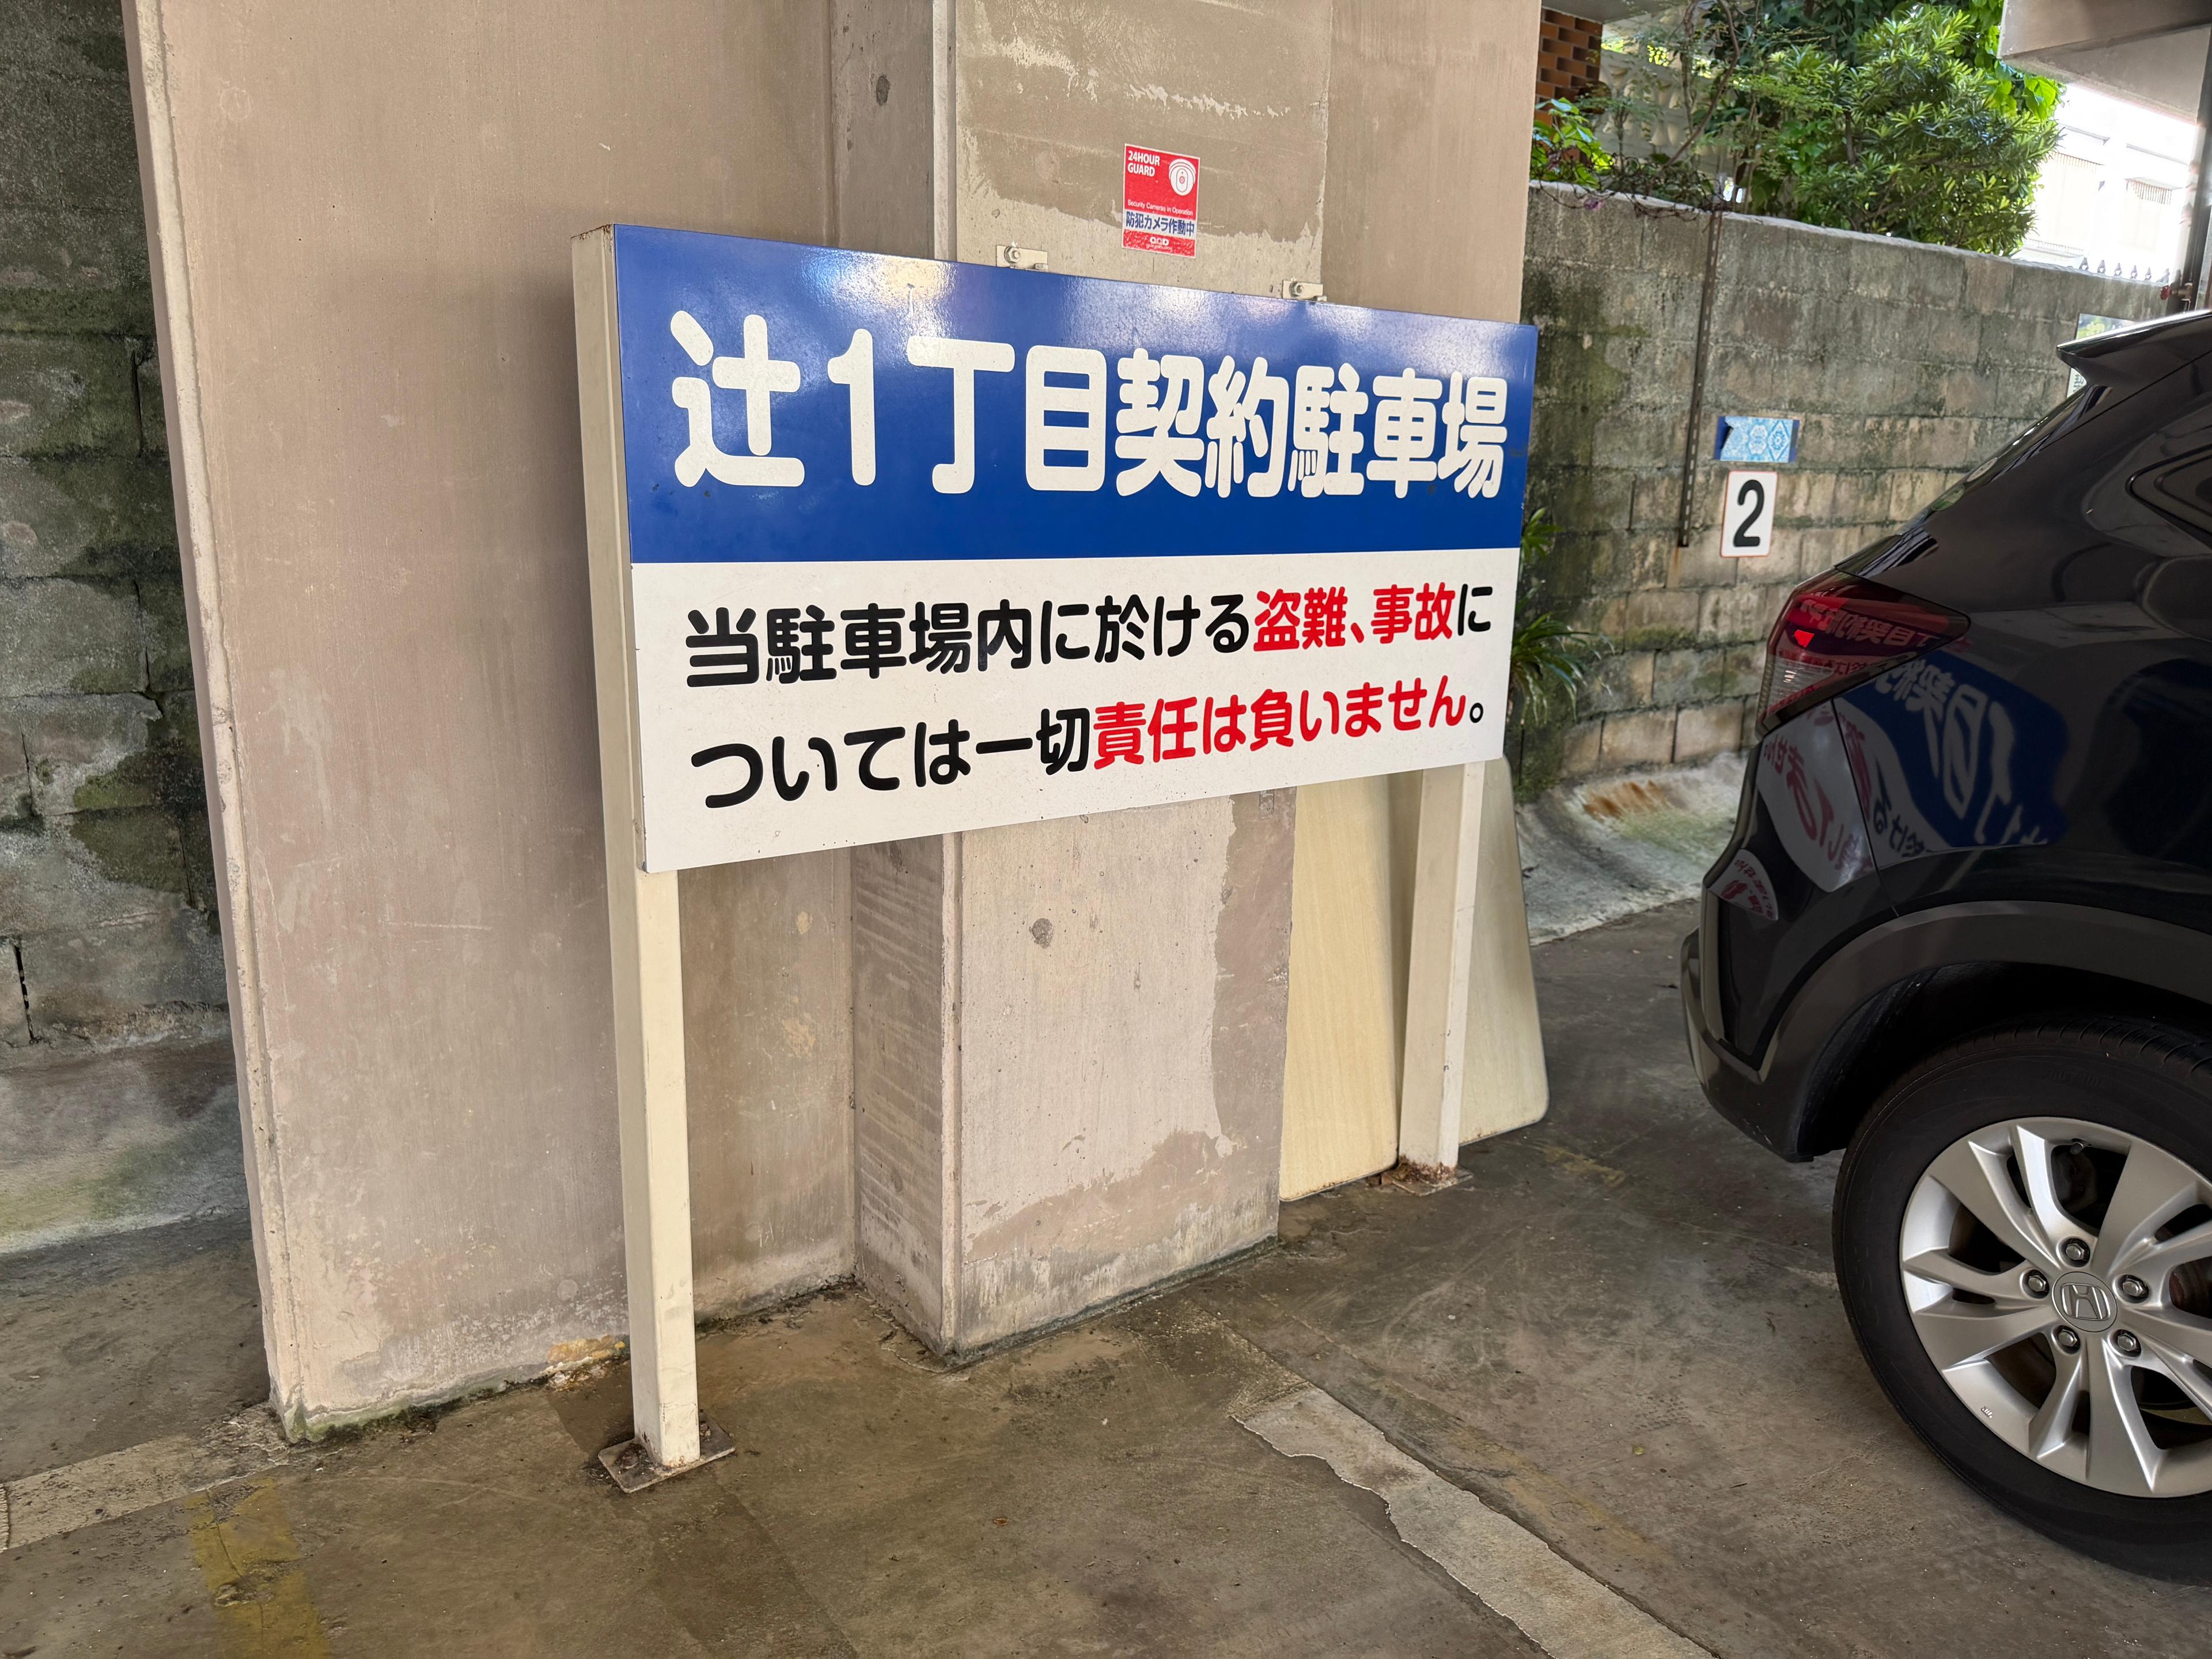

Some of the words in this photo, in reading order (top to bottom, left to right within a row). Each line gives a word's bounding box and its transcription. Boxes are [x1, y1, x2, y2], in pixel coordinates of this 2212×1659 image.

[1127, 162, 1156, 176] GUARD
[1128, 150, 1160, 166] 24HOUR
[1126, 211, 1195, 237] 防犯カメラ作動中
[1127, 199, 1145, 209] Security
[1146, 203, 1166, 213] Cameras
[1172, 207, 1194, 216] Operation
[671, 310, 1508, 498] 辻1丁目契約駐車場
[1733, 479, 1764, 547] 2
[685, 582, 1493, 688] 当駐車場内に於ける盗難、事故に
[691, 675, 1484, 808] ついては一切責任は負いません。
